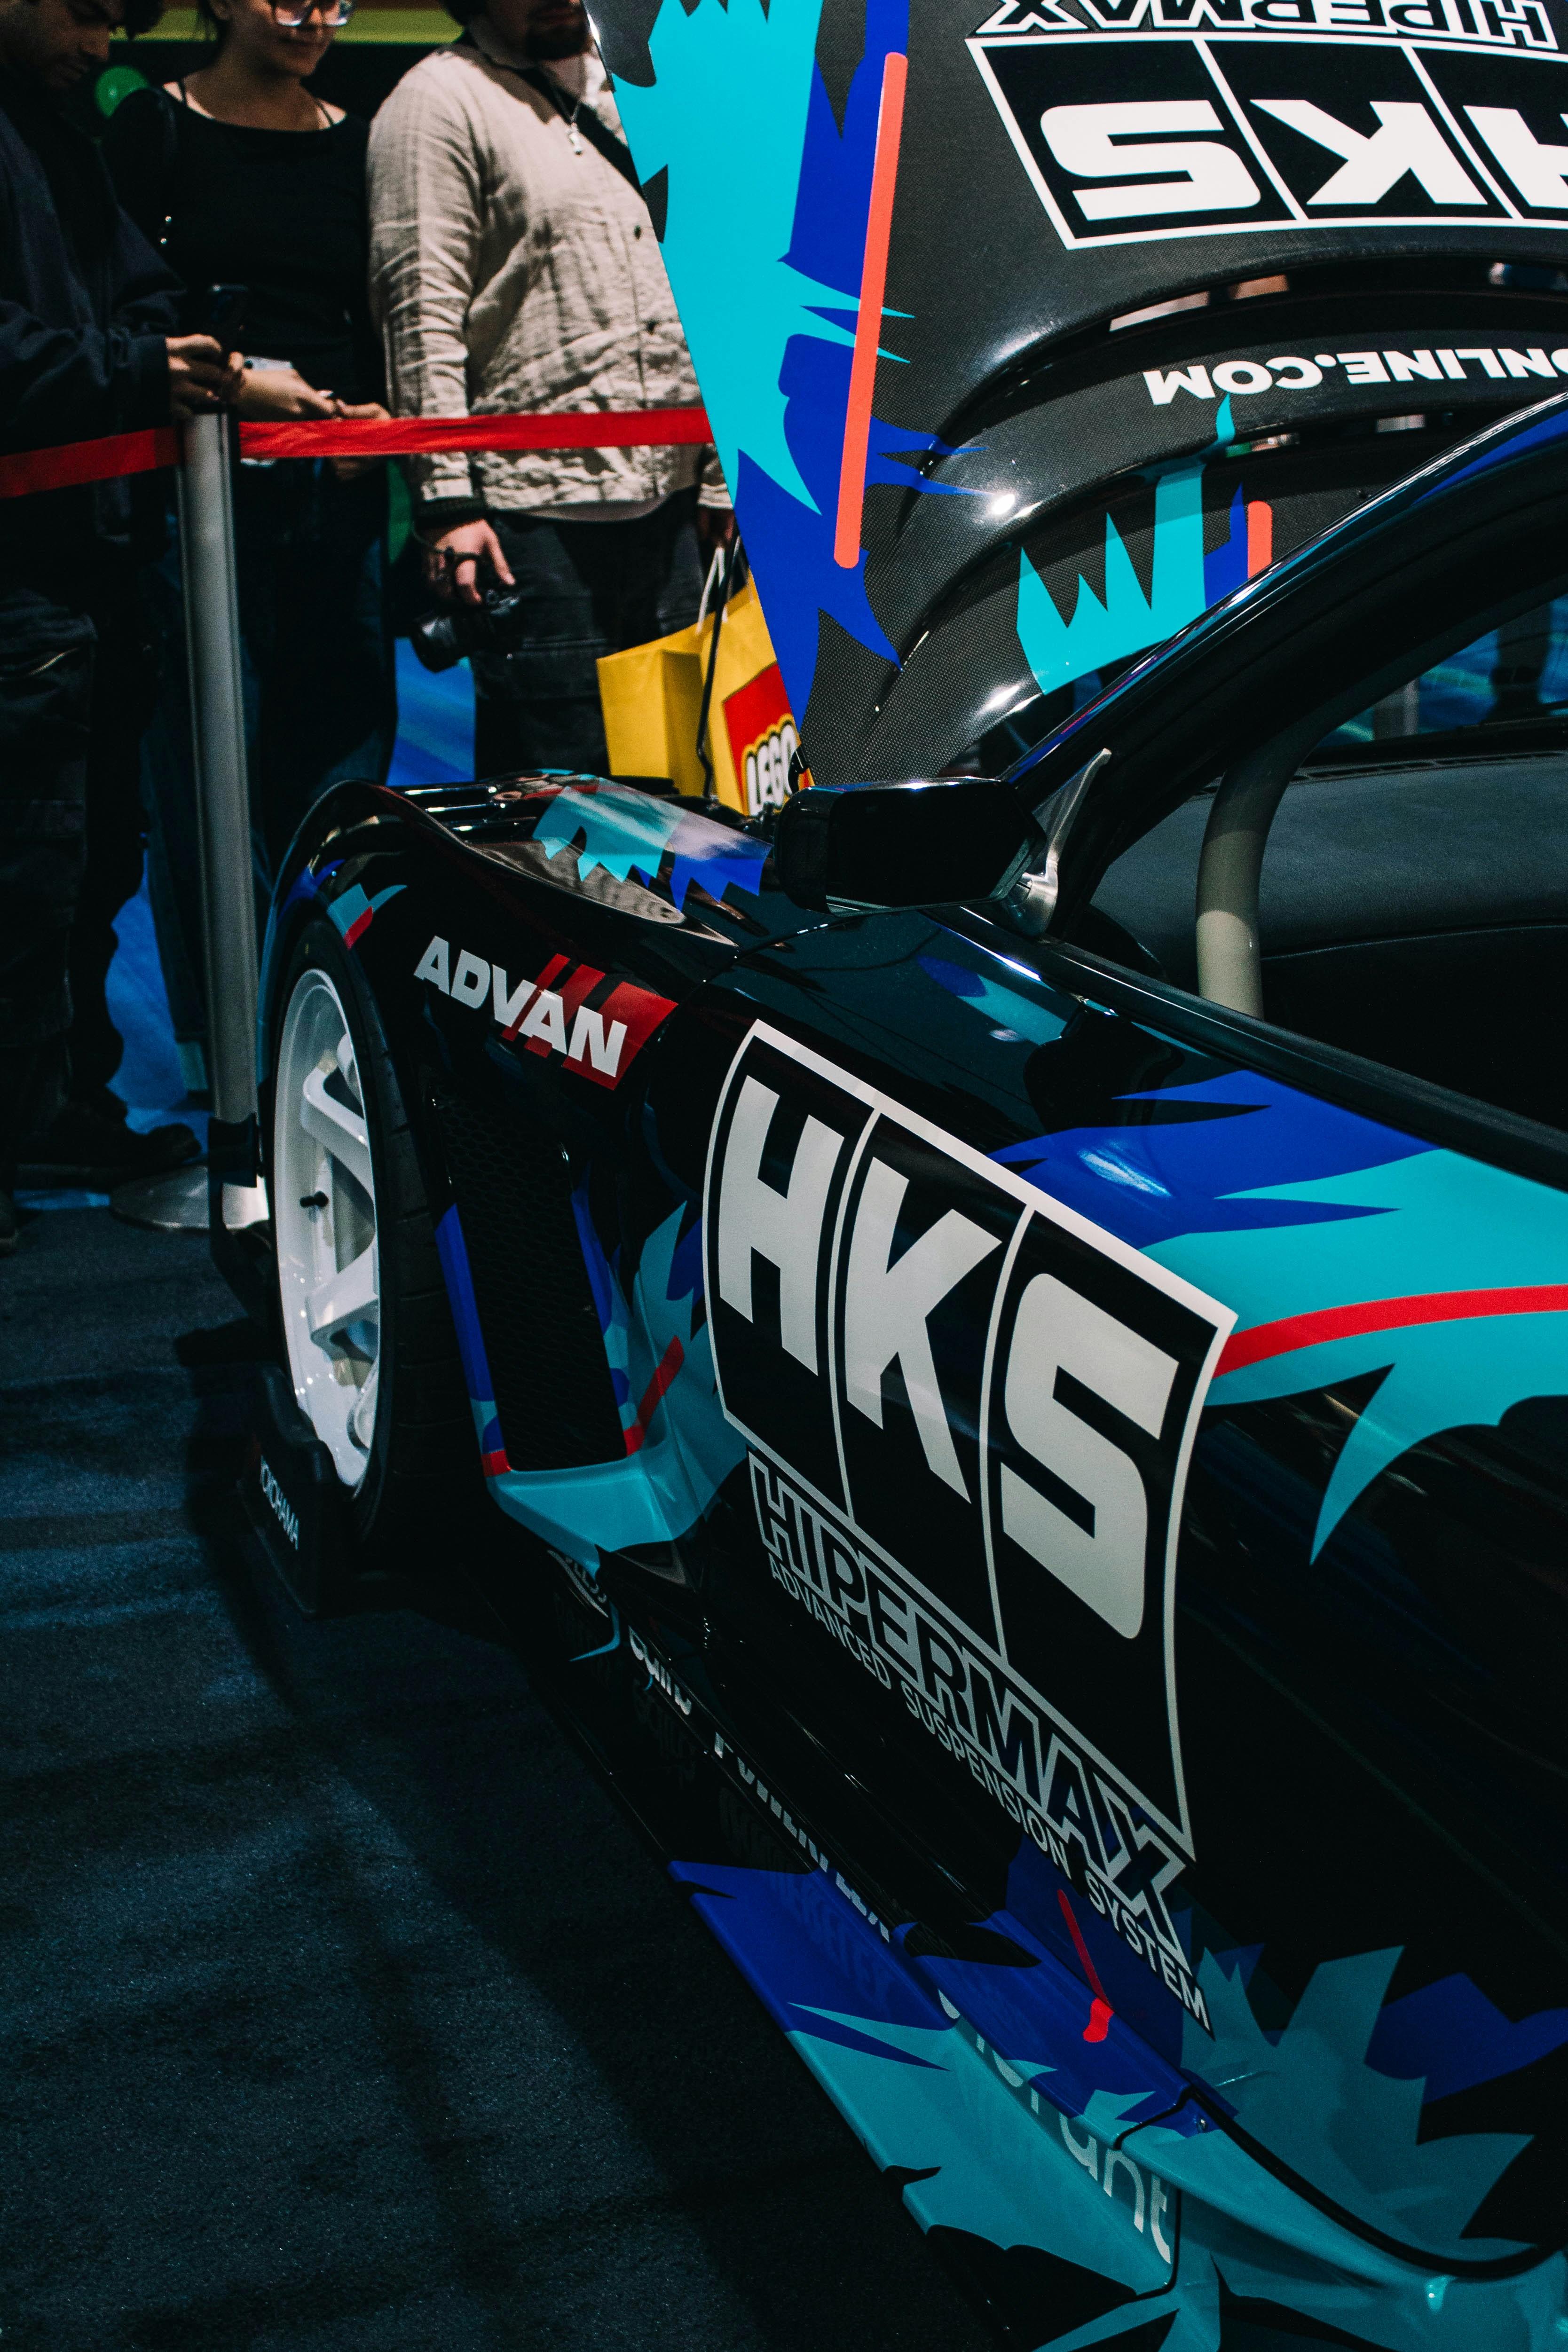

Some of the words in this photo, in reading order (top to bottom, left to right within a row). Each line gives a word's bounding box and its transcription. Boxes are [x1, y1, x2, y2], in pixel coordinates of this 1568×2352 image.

[1143, 348, 1568, 405] NLINE.COM
[413, 935, 628, 1078] ADVAN
[718, 1074, 1180, 1639] HKS
[749, 1451, 1191, 1976] HIPERMAX
[768, 1552, 892, 1690] ADVANCED
[900, 1680, 1072, 1880] SUSPENSION
[1084, 1869, 1212, 2032] SYSTEM
